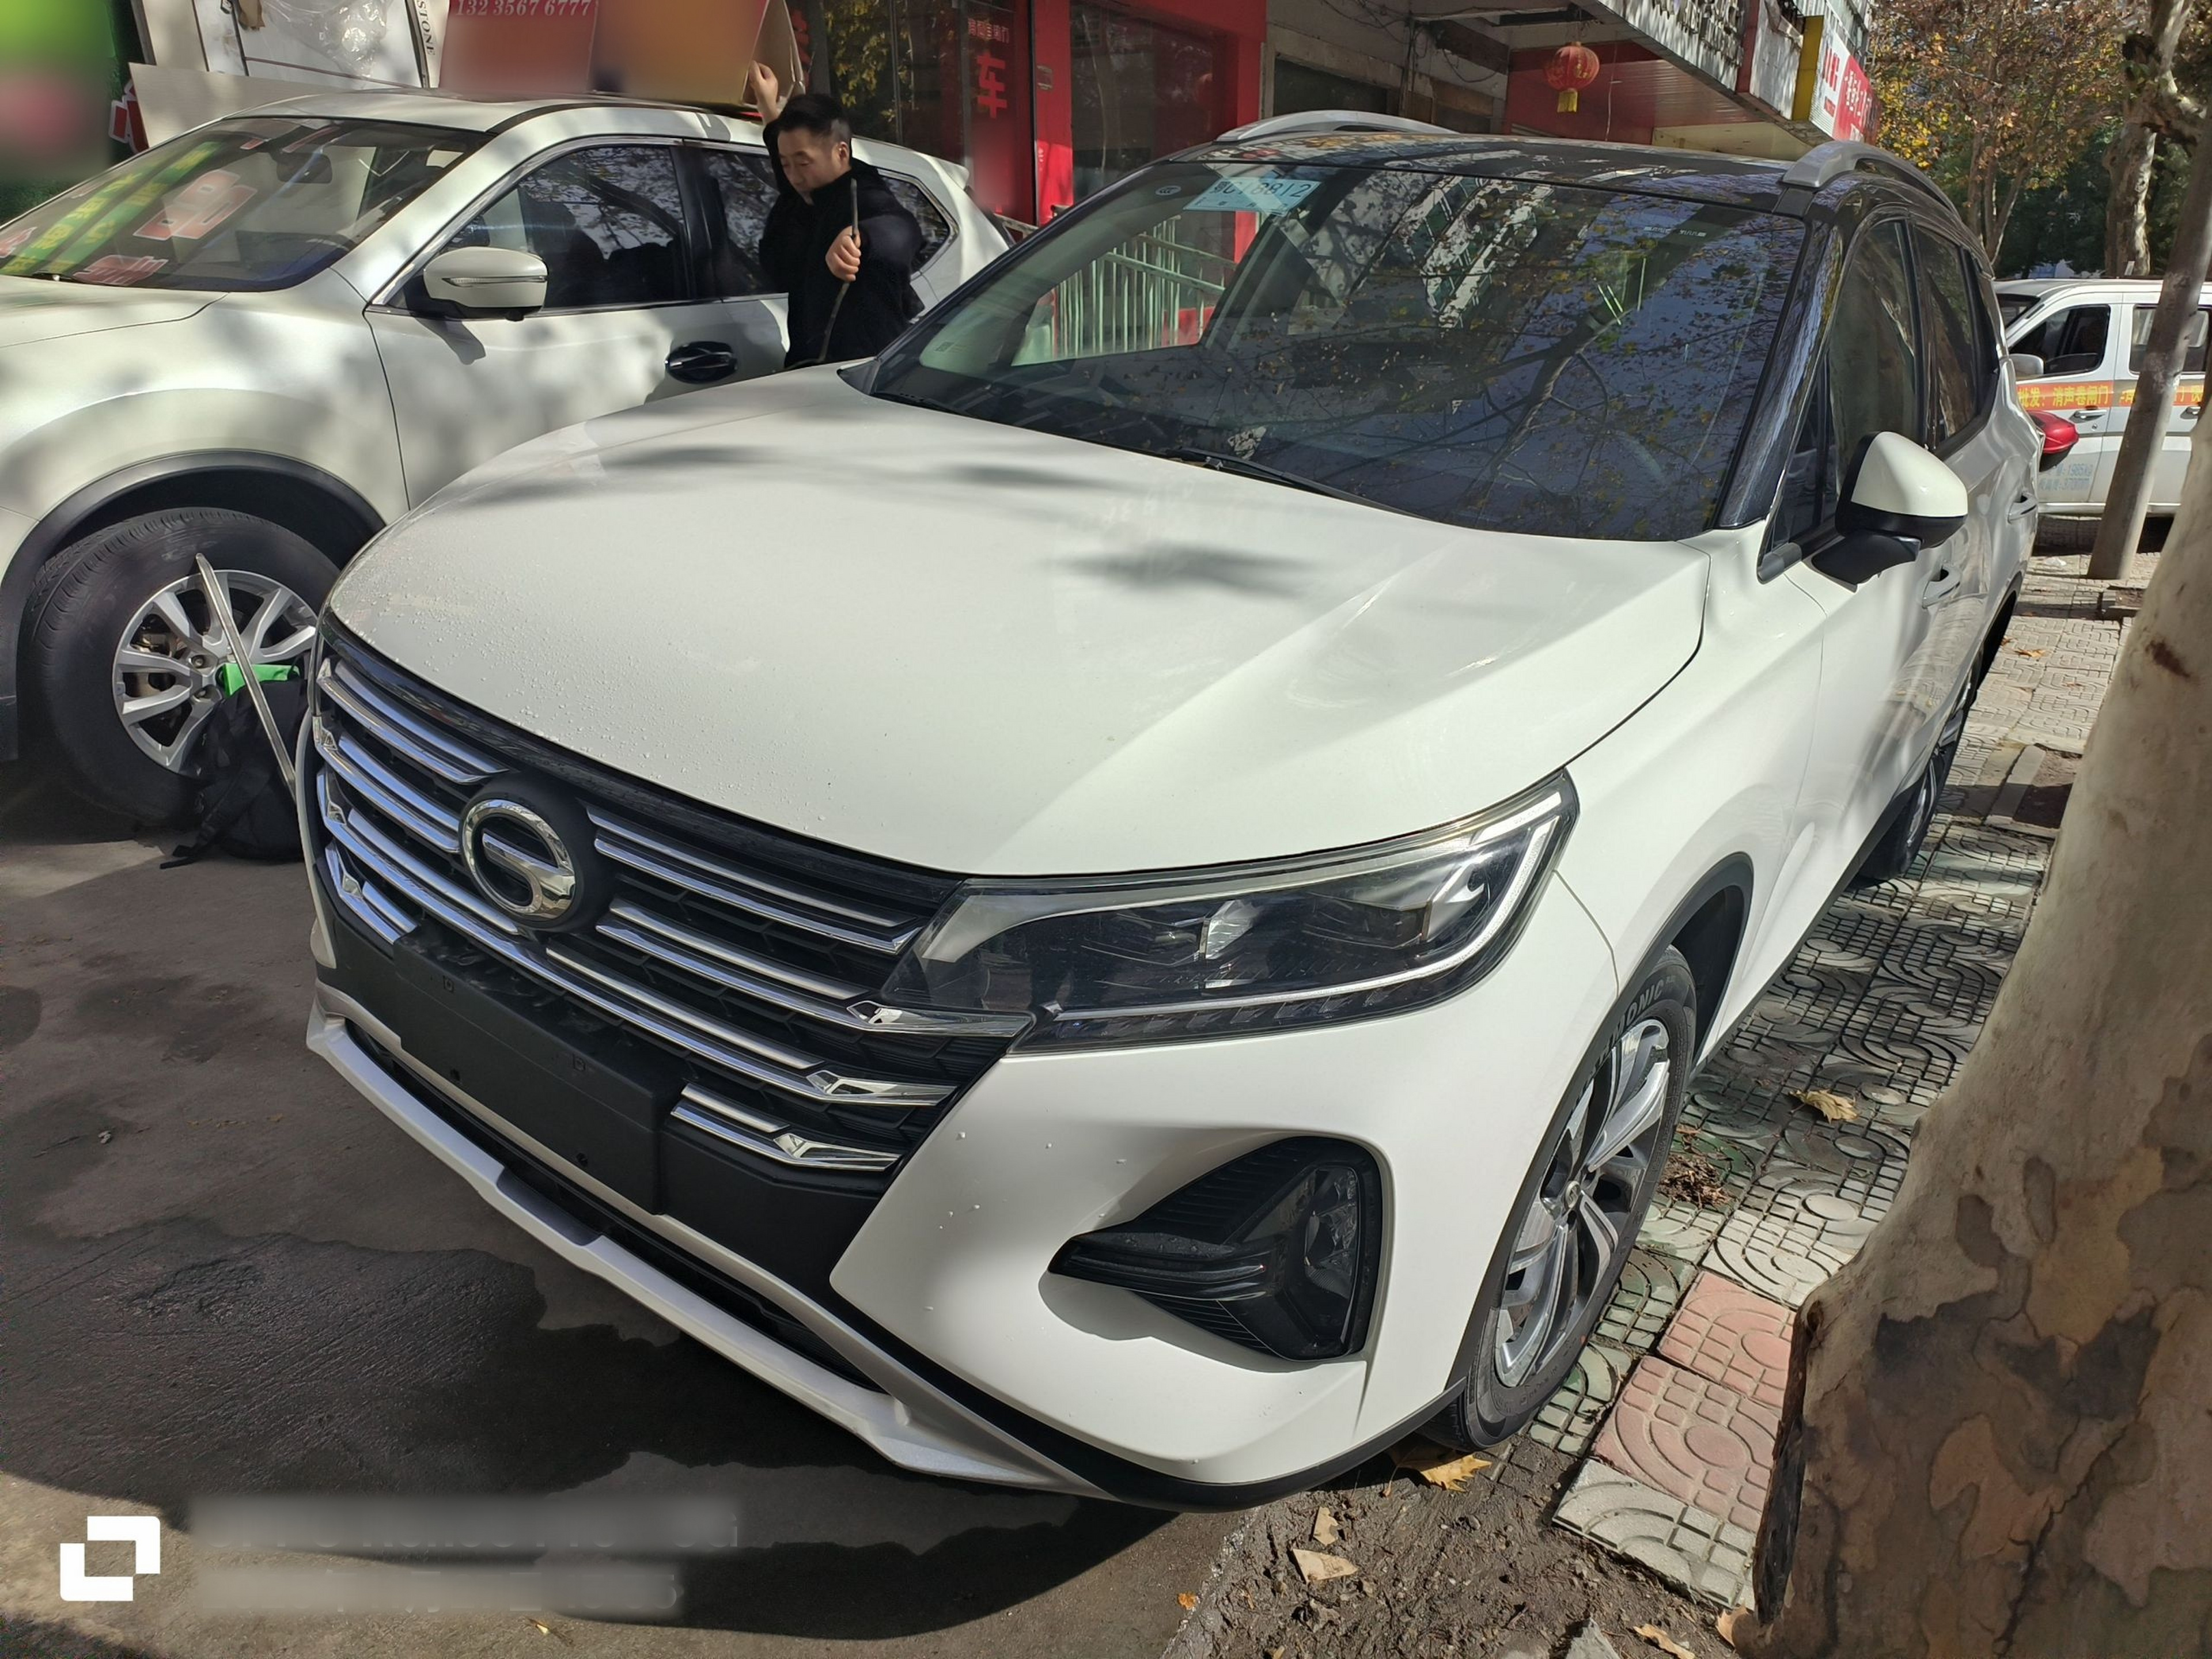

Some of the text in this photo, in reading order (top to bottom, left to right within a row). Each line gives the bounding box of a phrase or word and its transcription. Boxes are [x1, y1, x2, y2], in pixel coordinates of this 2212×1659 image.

[456, 0, 590, 16] 132 3567 6777
